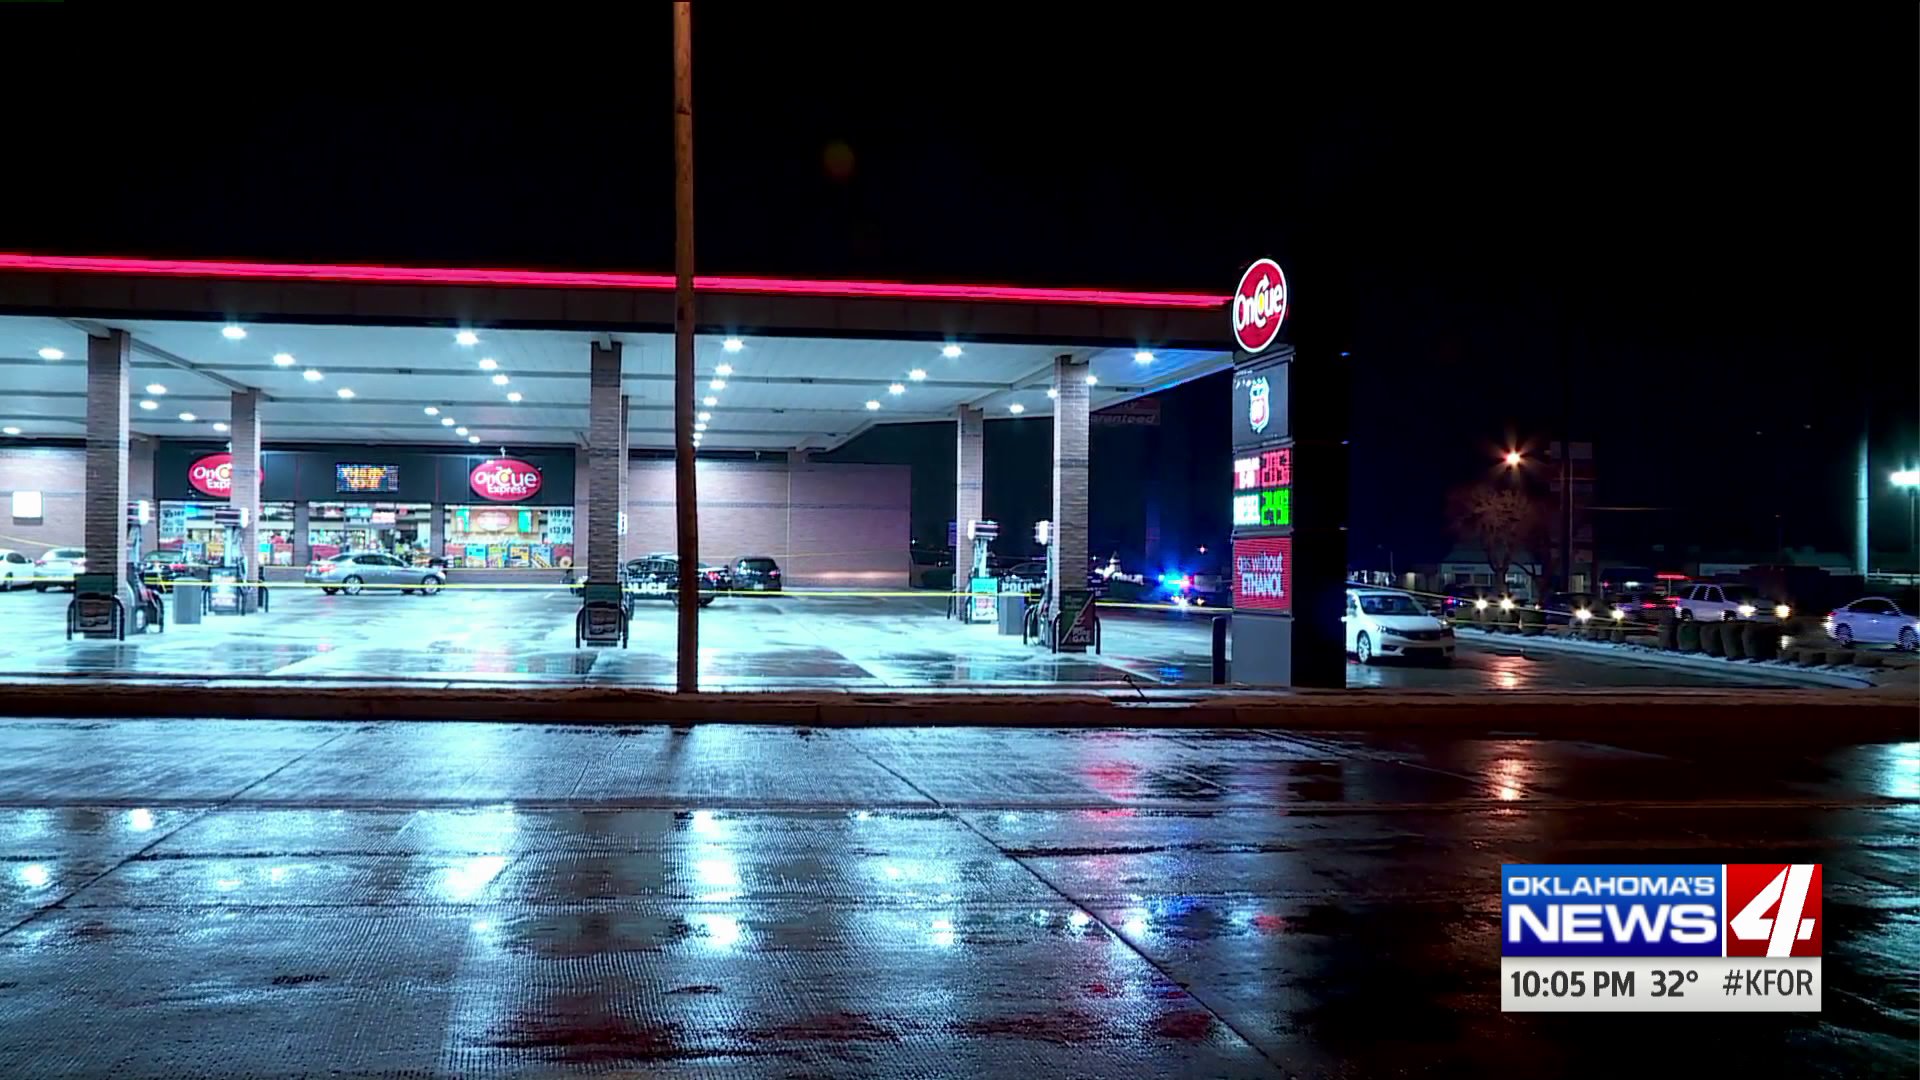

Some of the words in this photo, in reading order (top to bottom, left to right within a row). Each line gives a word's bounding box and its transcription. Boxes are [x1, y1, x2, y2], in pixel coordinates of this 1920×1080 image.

[1236, 273, 1284, 331] OnCue
[193, 463, 232, 481] OnC
[475, 466, 537, 487] OnCue
[207, 480, 232, 491] Expr
[487, 485, 526, 495] Express
[1241, 573, 1284, 597] ETHANOL
